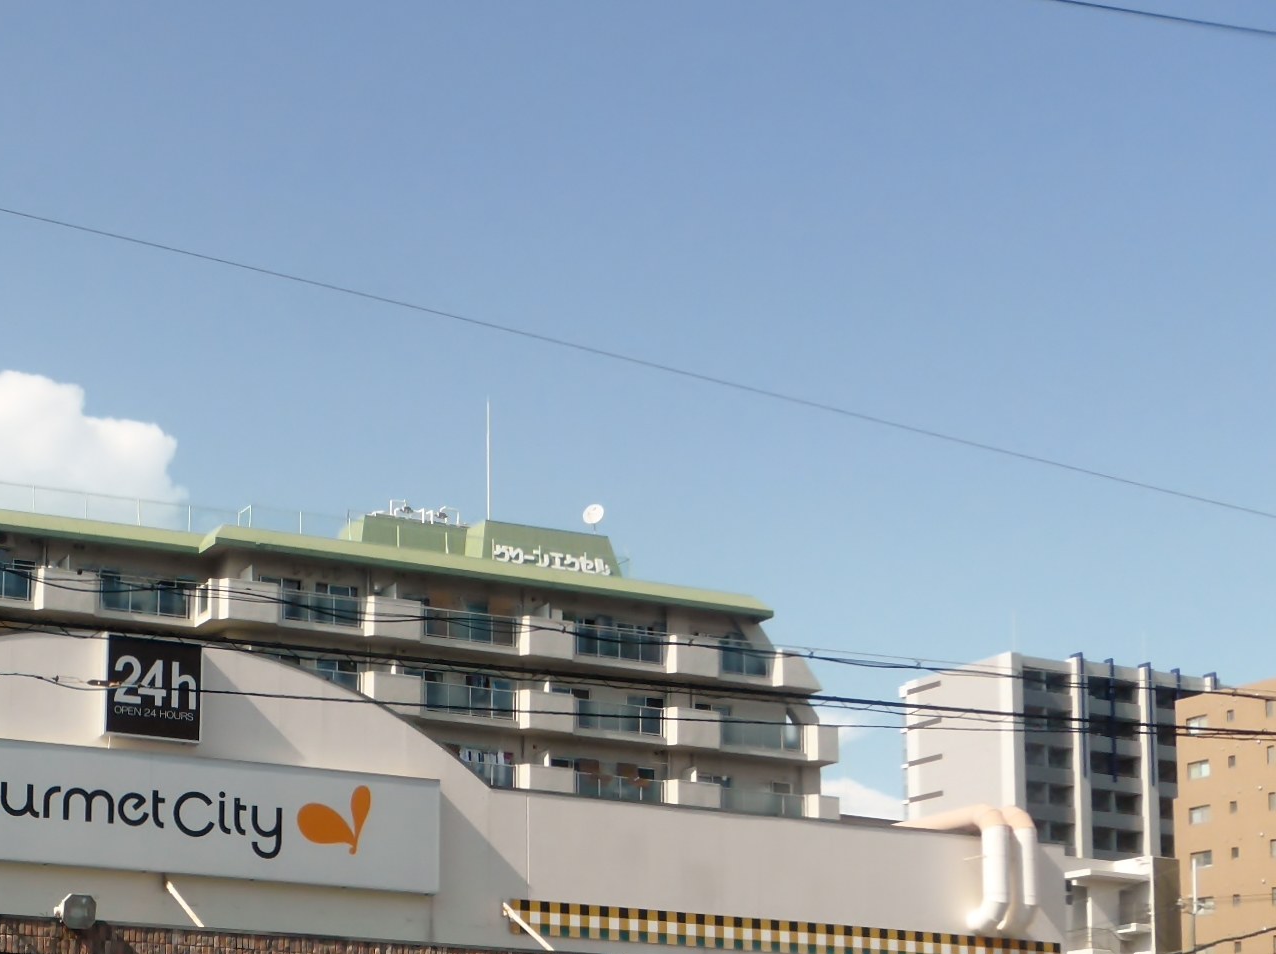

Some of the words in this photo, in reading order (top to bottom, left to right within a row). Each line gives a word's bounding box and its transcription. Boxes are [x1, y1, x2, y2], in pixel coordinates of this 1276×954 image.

[114, 655, 196, 710] 24h
[114, 705, 142, 716] OPEN
[144, 708, 156, 718] 24
[159, 710, 194, 721] HOURS
